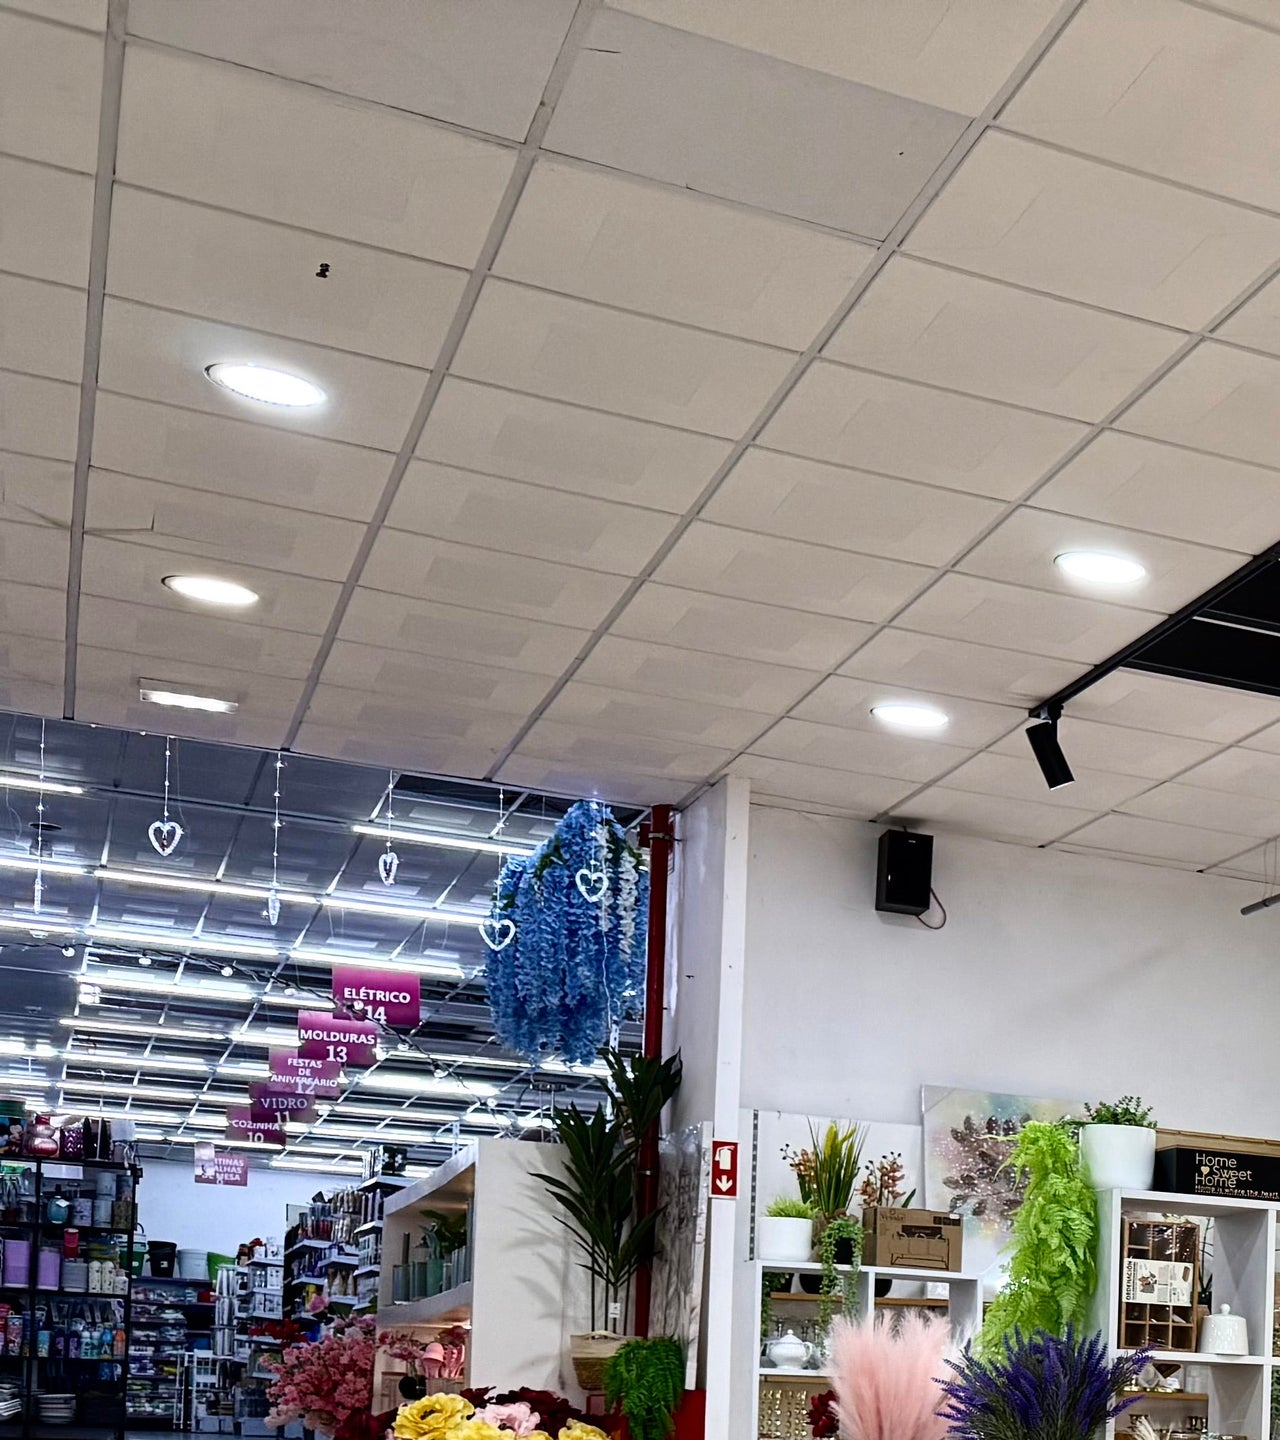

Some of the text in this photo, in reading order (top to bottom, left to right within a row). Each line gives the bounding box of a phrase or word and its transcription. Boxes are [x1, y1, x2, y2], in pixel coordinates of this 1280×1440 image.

[343, 986, 411, 1004] ELÉTRICO
[364, 1005, 387, 1025] 14
[300, 1029, 376, 1046] MOLDURAS
[326, 1045, 348, 1063] 13
[287, 1057, 323, 1069] FESTAS
[298, 1067, 311, 1076] DE
[260, 1097, 308, 1110] VIDRO
[232, 1119, 280, 1132] COZINHA
[274, 1111, 291, 1124] 11
[1195, 1152, 1237, 1168] Home
[1195, 1172, 1237, 1188] Home
[1212, 1165, 1252, 1181] Sweet
